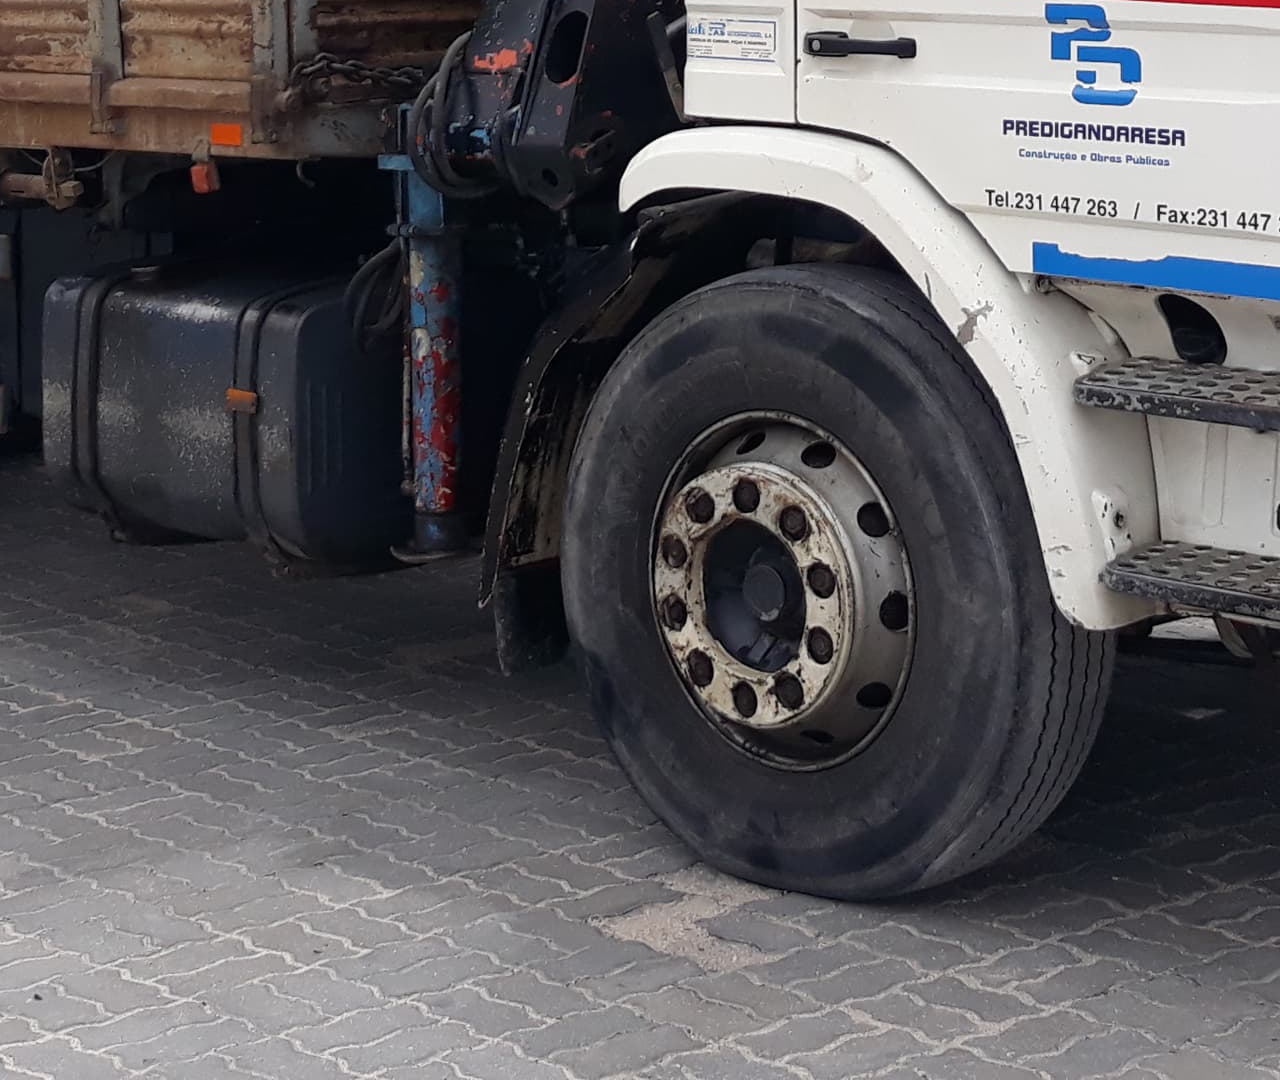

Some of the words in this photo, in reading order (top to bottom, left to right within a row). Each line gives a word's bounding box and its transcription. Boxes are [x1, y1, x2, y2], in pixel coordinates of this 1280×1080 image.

[1002, 119, 1186, 147] PREDIGANDARESA
[1080, 153, 1087, 162] e
[1090, 152, 1122, 164] Obras
[985, 189, 1044, 212] Tel.231
[1050, 196, 1081, 215] 447
[1087, 199, 1118, 218] 263
[1156, 204, 1228, 228] Fax:231
[1236, 211, 1271, 232] 447
